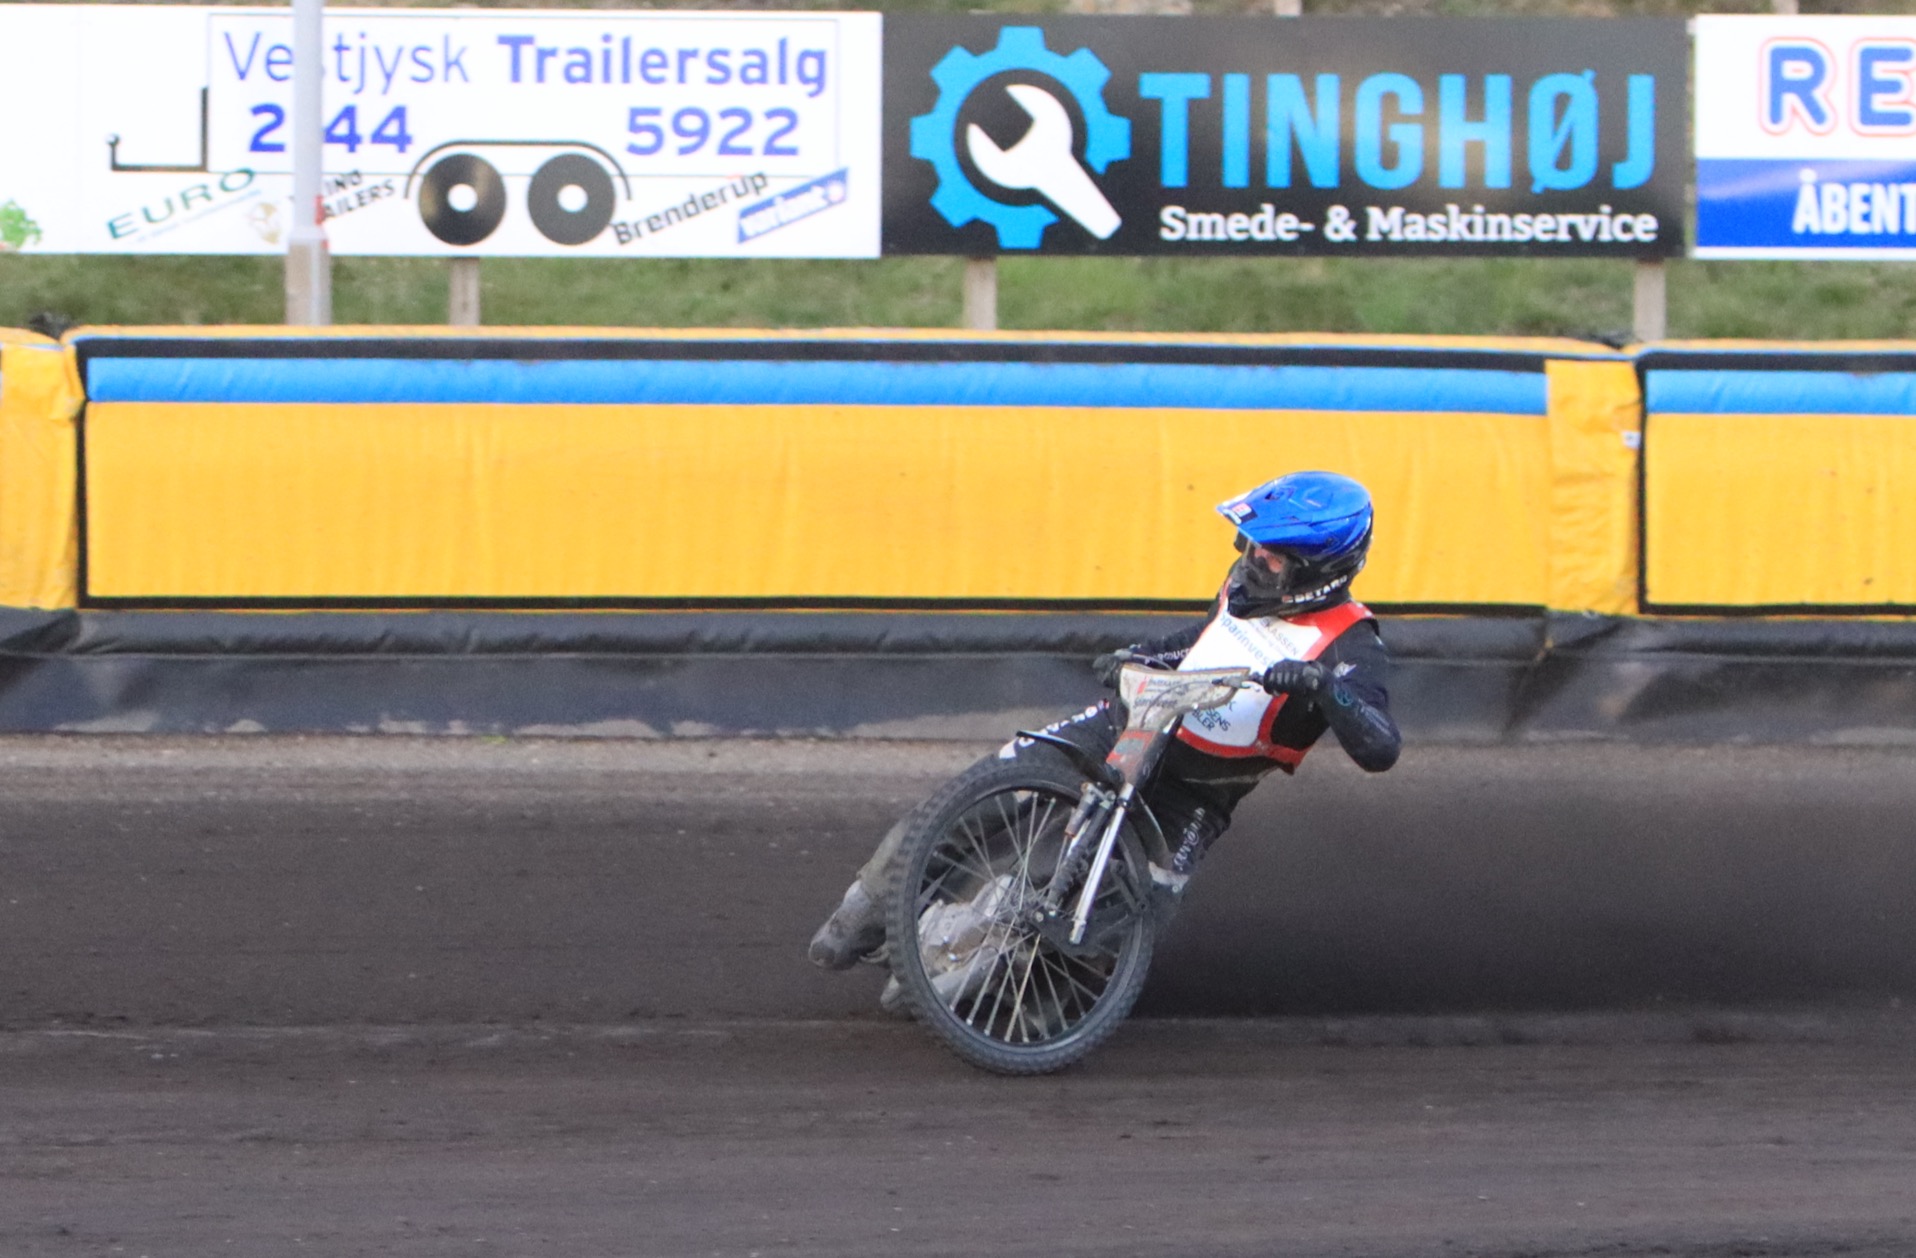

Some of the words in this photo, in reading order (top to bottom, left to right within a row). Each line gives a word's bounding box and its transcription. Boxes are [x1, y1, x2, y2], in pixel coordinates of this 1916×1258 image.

[223, 31, 470, 95] Vetjysk
[497, 33, 827, 98] Trailersalg
[249, 103, 414, 154] 244
[626, 106, 800, 156] 5922
[1140, 69, 1656, 194] TINGHØJ
[106, 167, 256, 240] EURO
[318, 178, 396, 223] AILERS
[612, 171, 769, 245] Brenderup
[1160, 204, 1313, 242] Smede-
[1323, 208, 1357, 242] &
[1366, 204, 1659, 243] Maskinservice
